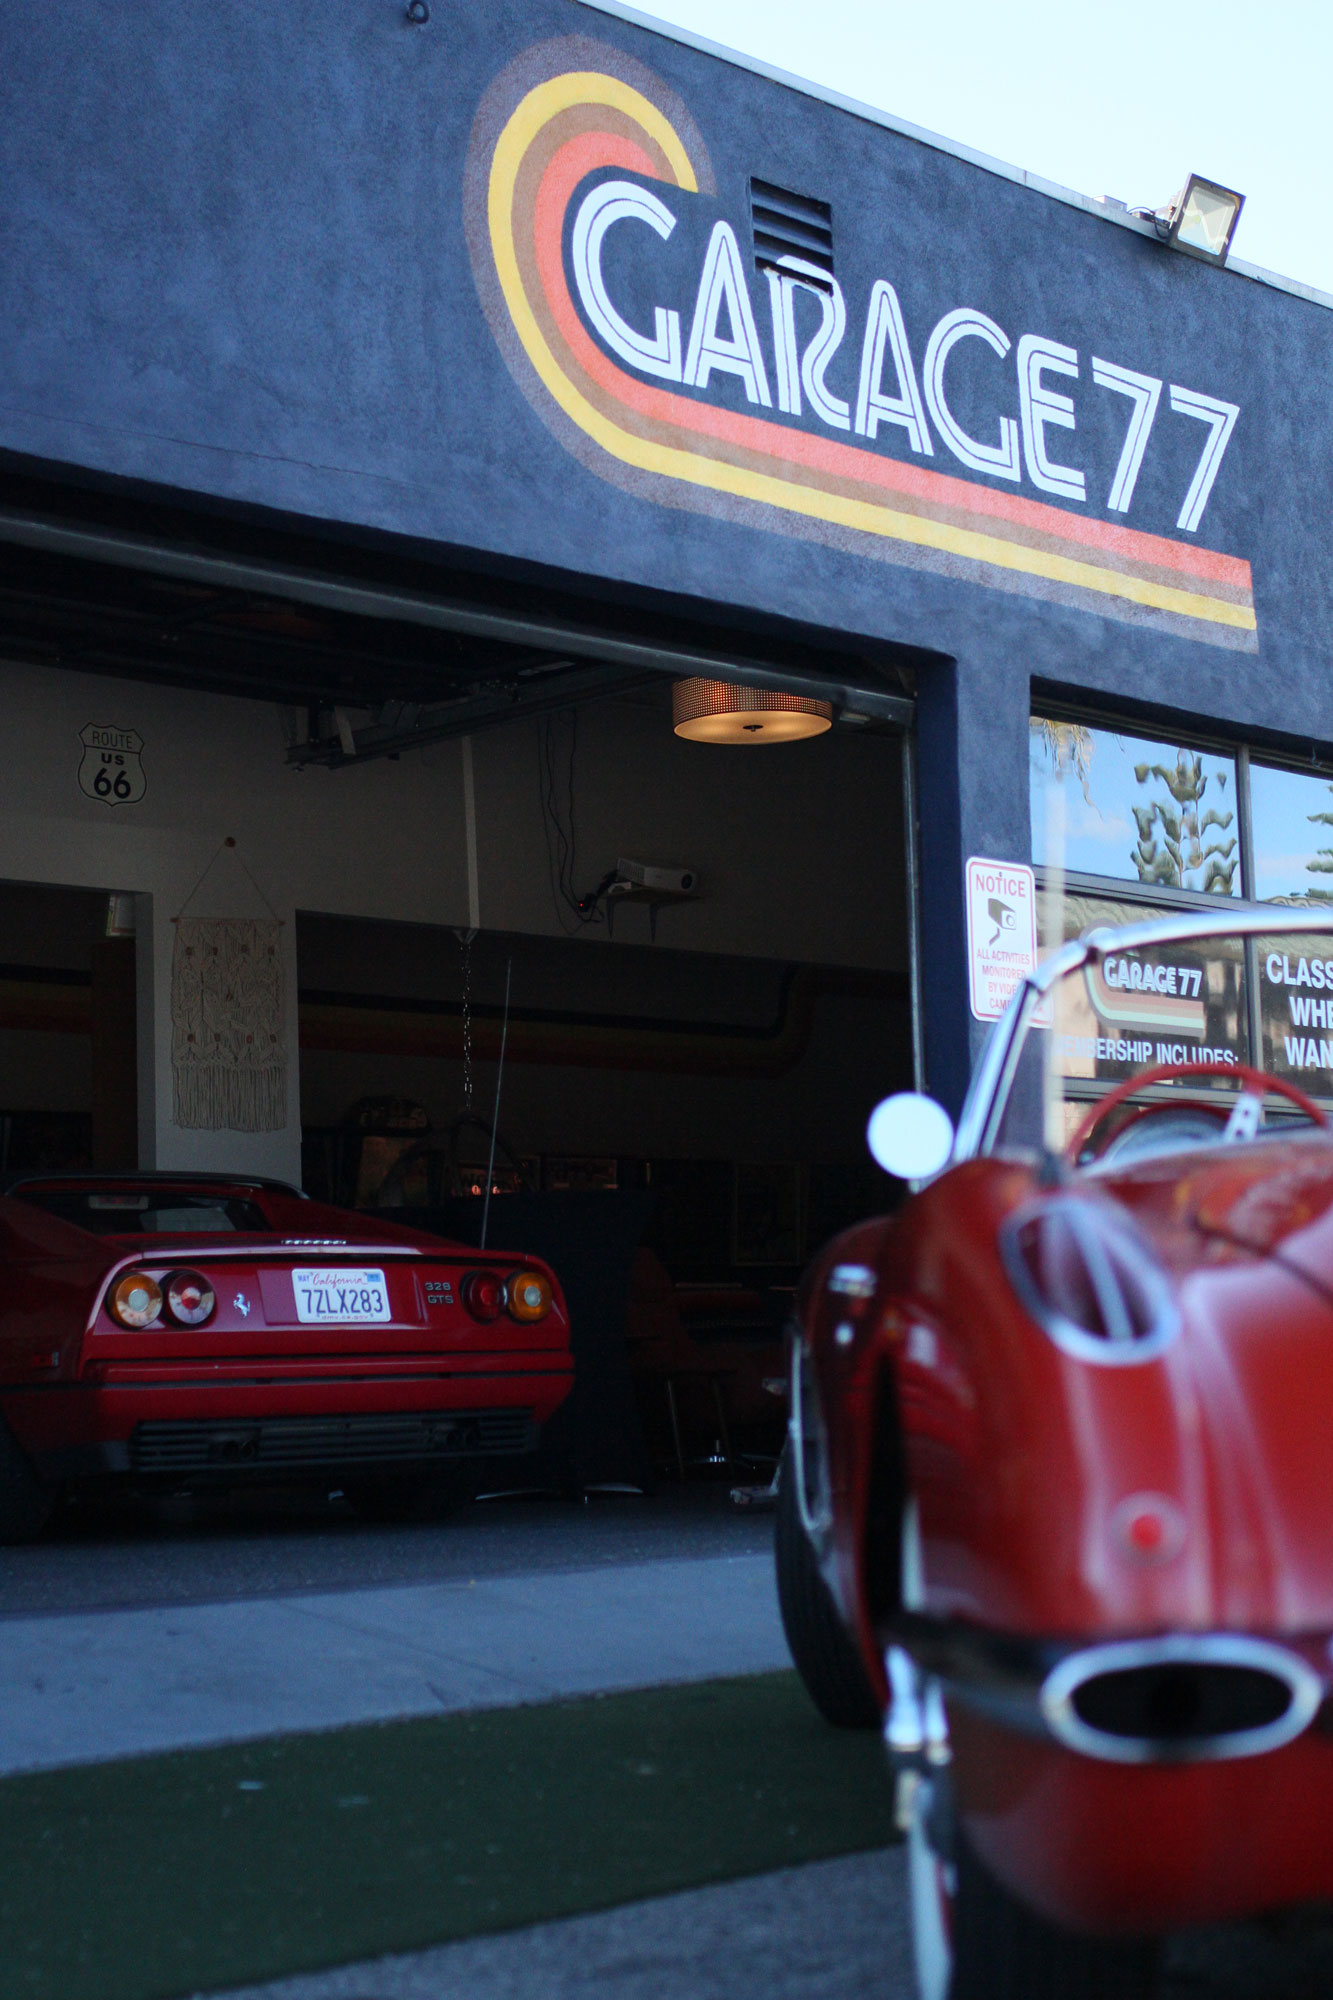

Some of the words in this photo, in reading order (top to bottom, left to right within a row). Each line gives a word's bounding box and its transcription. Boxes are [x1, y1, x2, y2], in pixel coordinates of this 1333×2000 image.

[572, 180, 1086, 502] GARAGE
[1091, 356, 1240, 533] 77
[92, 730, 133, 750] ROUTE
[101, 753, 125, 766] US
[94, 767, 131, 799] 66
[975, 872, 1026, 898] NOTICE
[977, 948, 990, 960] ALL
[992, 950, 1031, 966] ACTIVITIES
[982, 965, 1027, 981] MONITORED
[1104, 956, 1177, 994] GARAGE
[1178, 967, 1202, 998] 77
[988, 982, 998, 993] BY
[999, 983, 1017, 996] VIDE
[1053, 1035, 1153, 1063] MEMBERSHIP
[313, 1273, 368, 1289] California
[424, 1282, 452, 1291] 328
[301, 1289, 384, 1314] 7ZLX283
[427, 1295, 454, 1304] GTS
